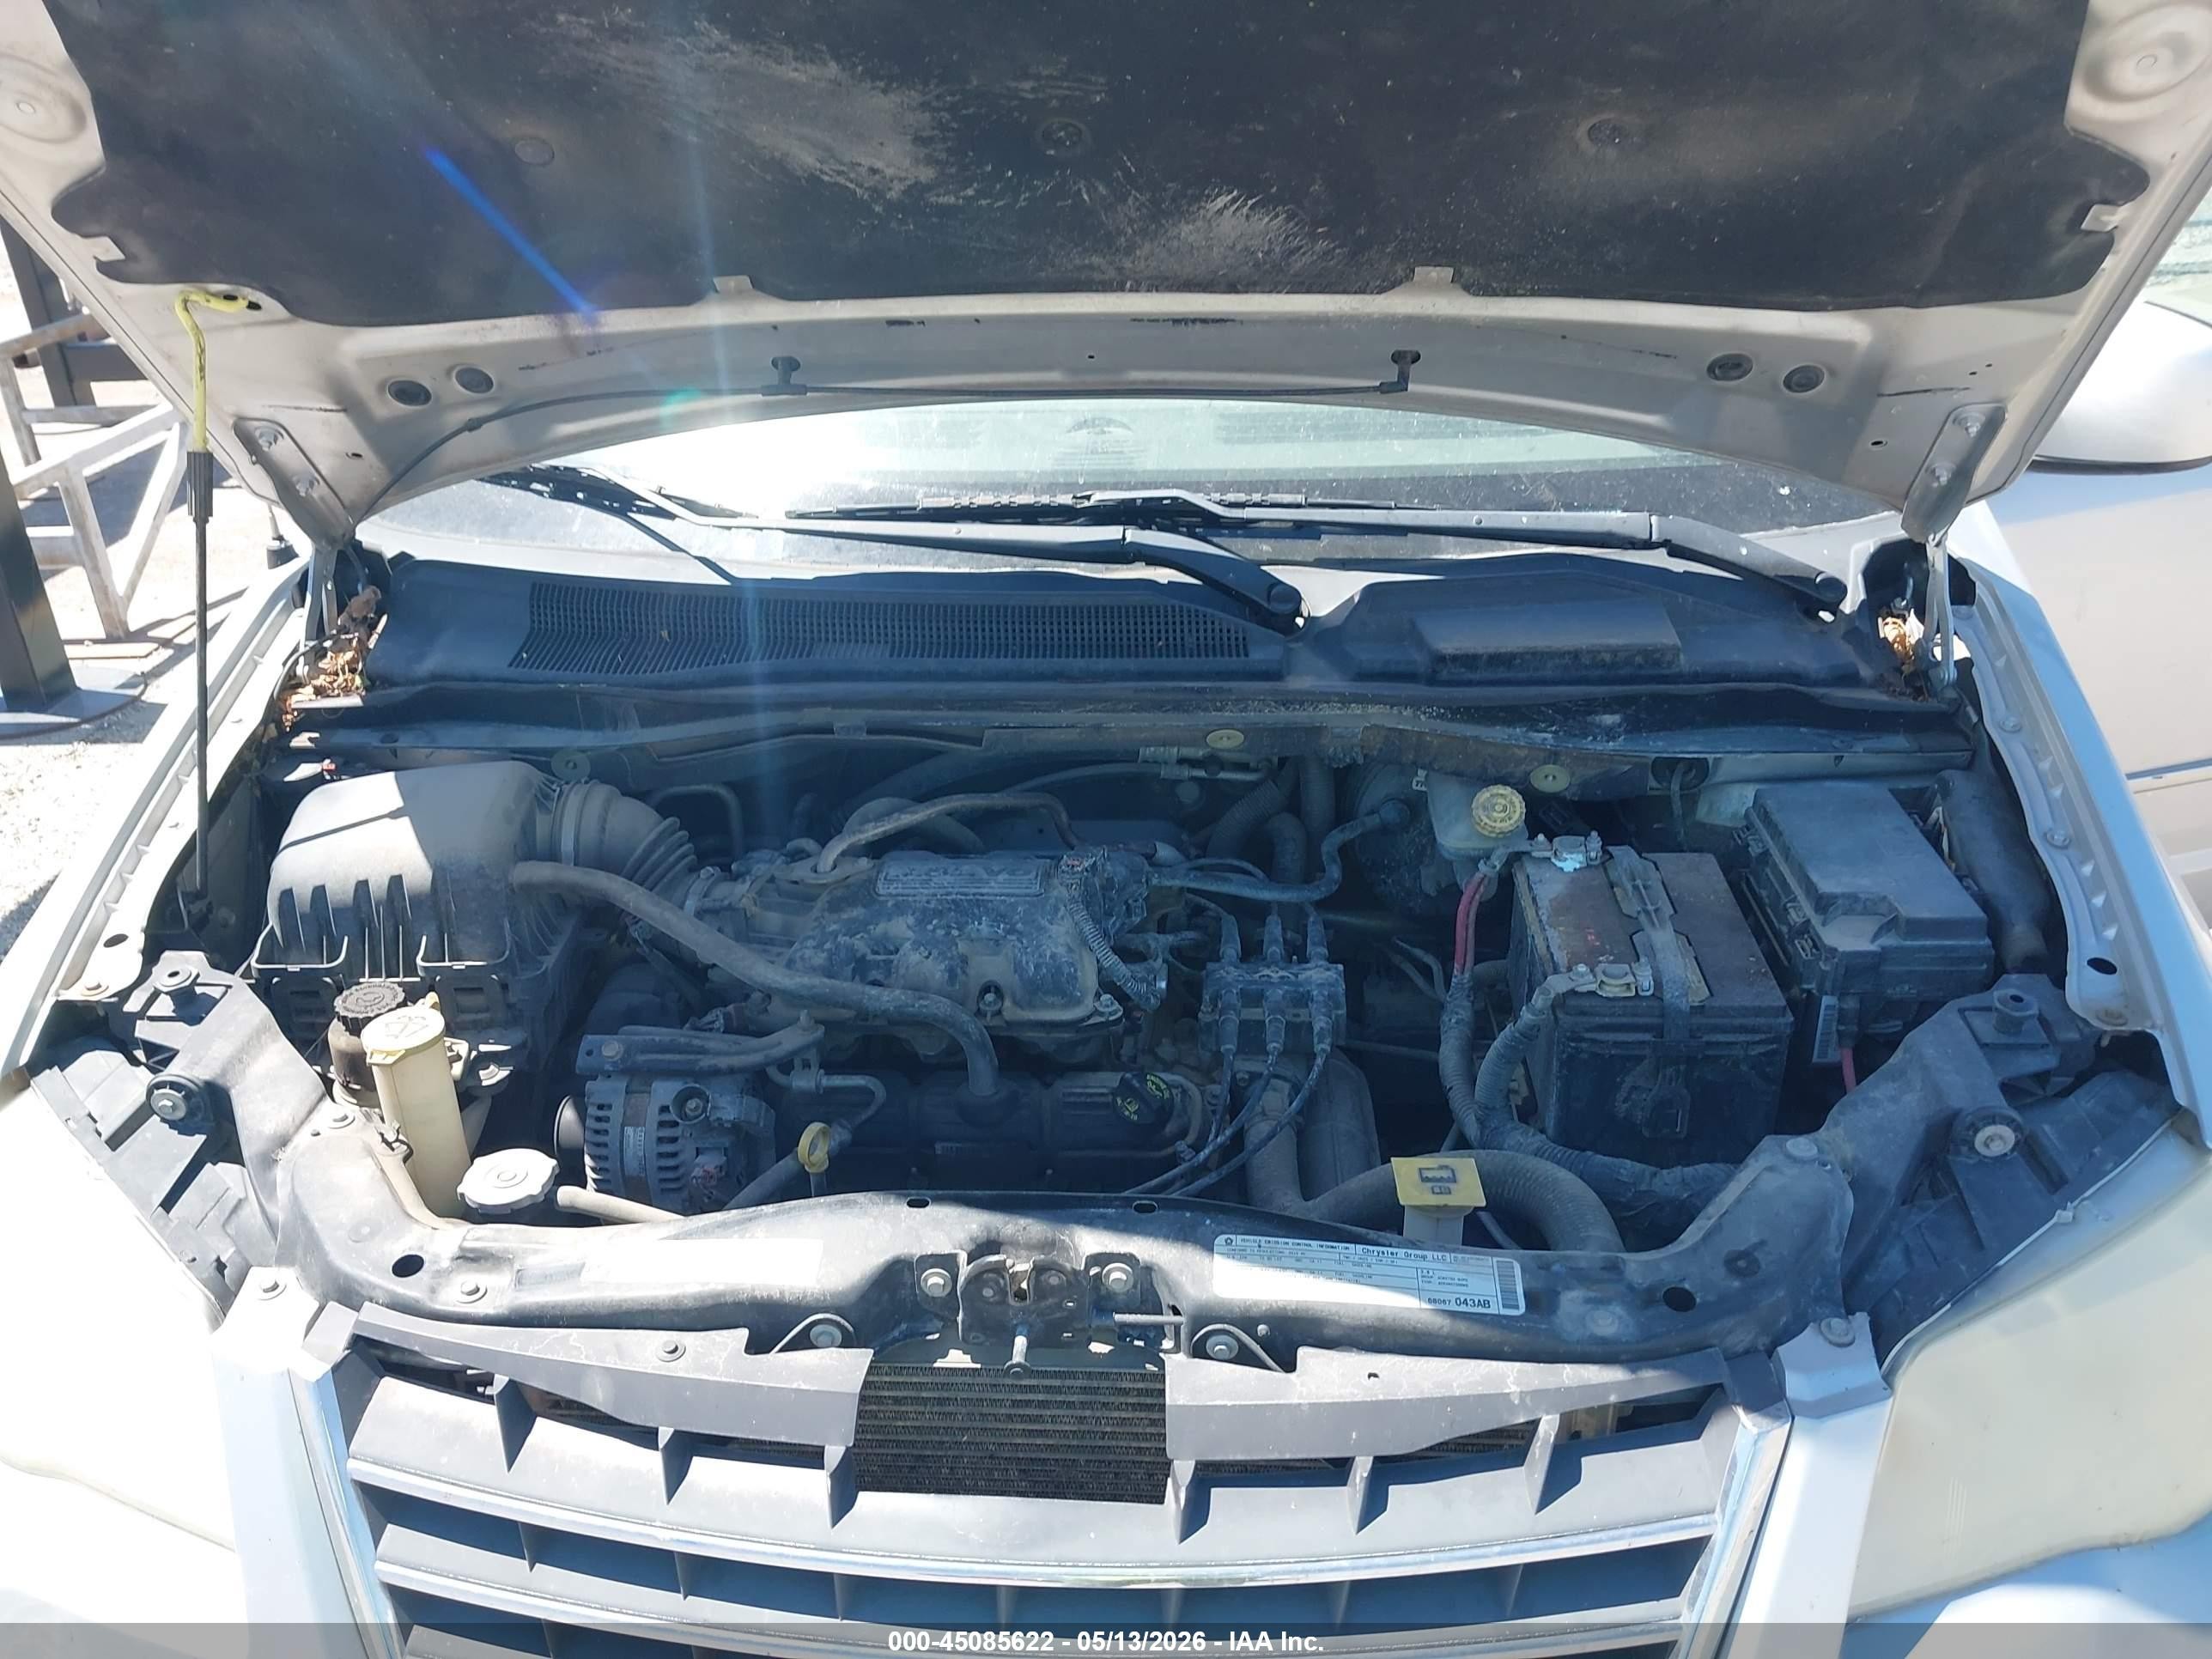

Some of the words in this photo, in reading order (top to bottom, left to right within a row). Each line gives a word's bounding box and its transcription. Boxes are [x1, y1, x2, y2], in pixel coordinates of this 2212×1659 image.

[1361, 1247, 1399, 1257] Chrysler
[1404, 1250, 1429, 1262] Group
[1431, 1253, 1447, 1261] LLC
[1455, 1297, 1492, 1310] 043AB
